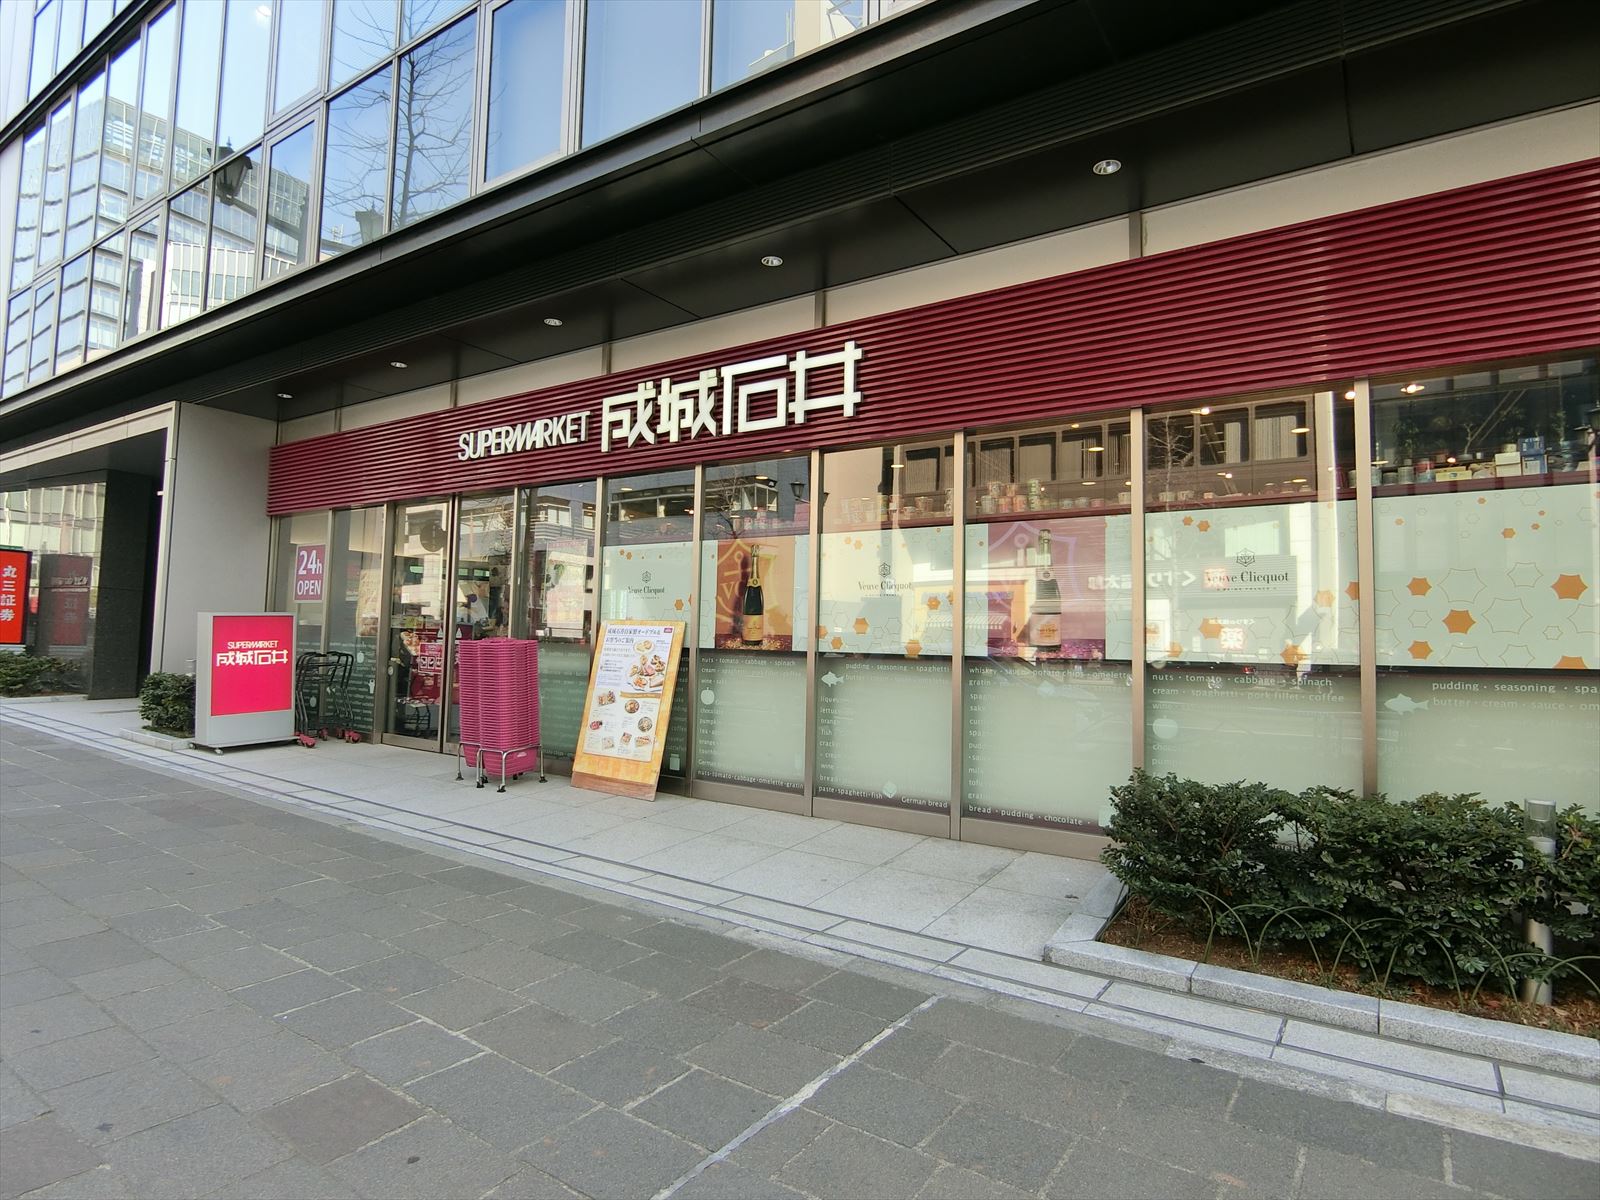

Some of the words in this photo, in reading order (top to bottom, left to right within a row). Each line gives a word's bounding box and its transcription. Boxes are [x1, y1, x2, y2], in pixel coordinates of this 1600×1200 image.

[600, 340, 864, 453] 成城石井
[457, 410, 591, 461] SUPERMARKET
[298, 549, 322, 575] 24h
[1240, 571, 1289, 584] Clicquot
[297, 580, 322, 596] OPEN
[227, 640, 280, 650] SUPERMARKET
[216, 649, 289, 667] 成城石井
[916, 664, 950, 673] spaghetti
[968, 667, 997, 676] whiskey
[1032, 669, 1060, 678] potato
[1062, 669, 1084, 679] chips
[1185, 674, 1222, 683] tomato
[1234, 675, 1275, 687] cabbage
[1291, 678, 1333, 689] spinach
[1432, 681, 1479, 692] pudding
[1494, 683, 1556, 694] seasoning
[1574, 684, 1598, 694] spa
[1308, 693, 1345, 703] coffee
[1481, 699, 1518, 709] cream
[838, 787, 868, 797] spaghetti
[871, 790, 883, 799] fish
[901, 796, 927, 806] German
[928, 798, 948, 808] bread
[968, 804, 992, 814] bread
[1000, 808, 1034, 821] pudding
[1043, 814, 1083, 826] chocolate
